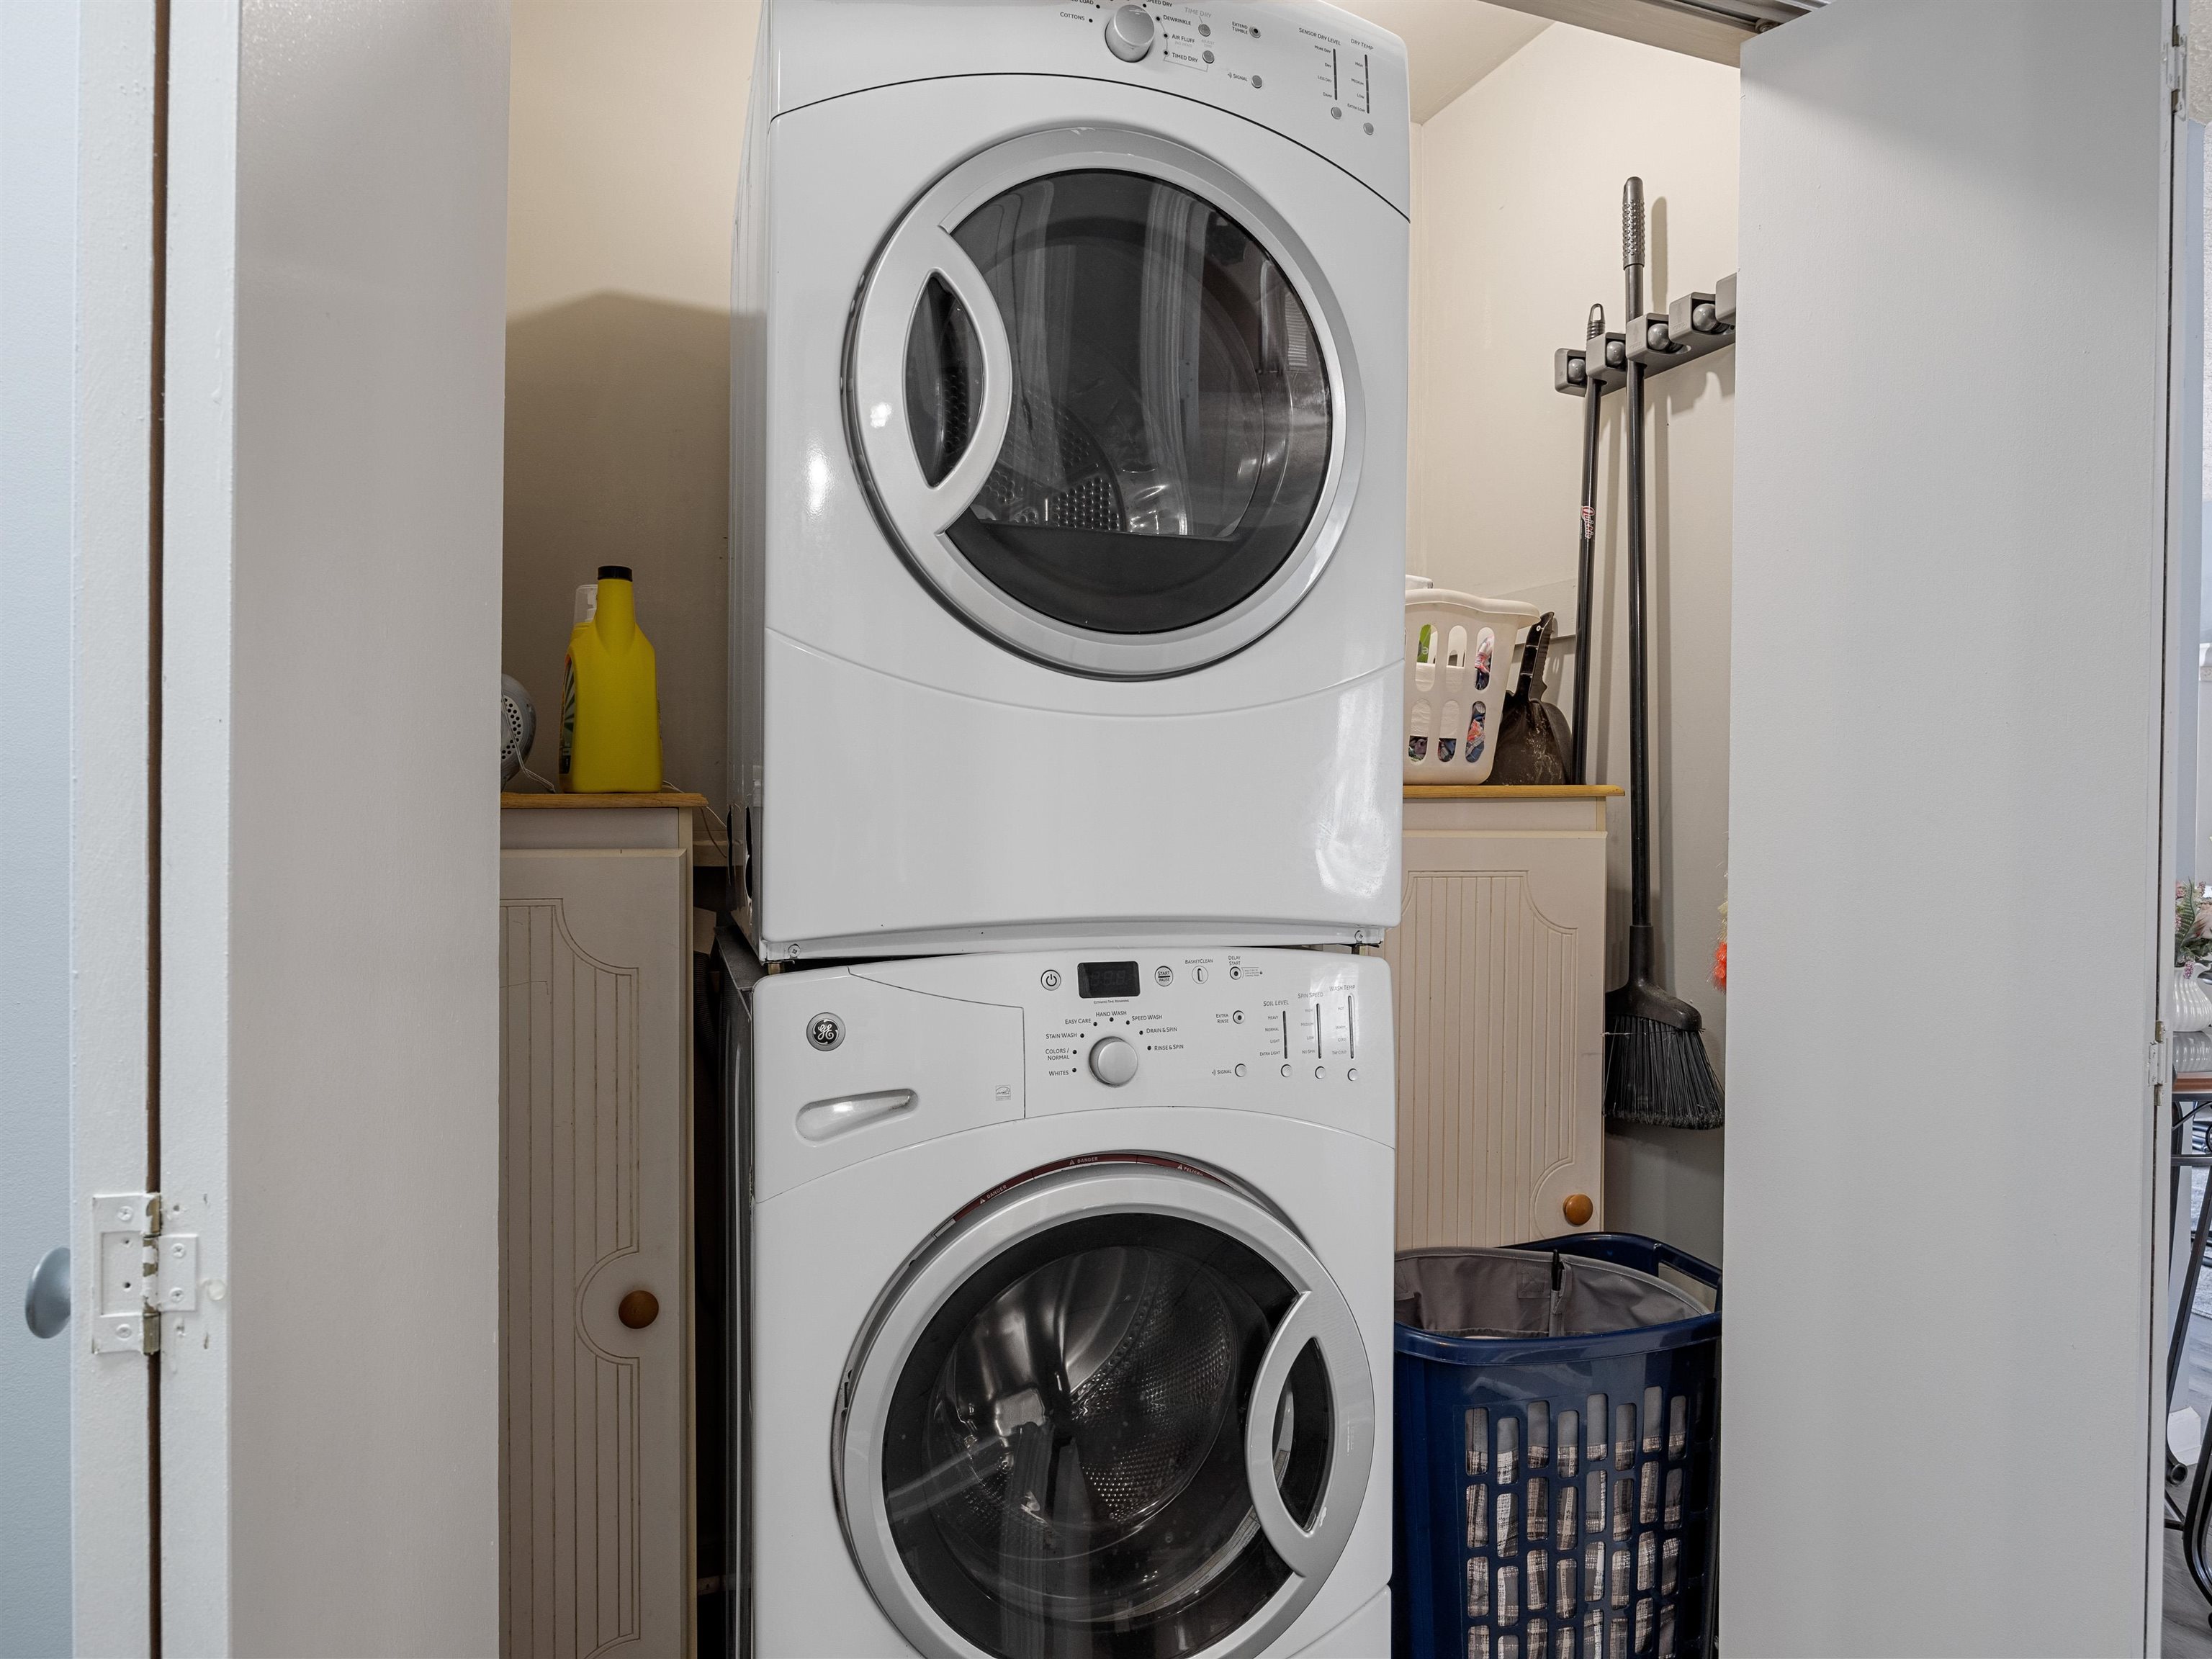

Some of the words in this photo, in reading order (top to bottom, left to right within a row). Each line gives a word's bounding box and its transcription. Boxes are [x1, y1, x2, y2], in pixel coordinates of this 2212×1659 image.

[1060, 12, 1085, 21] COTTONS
[1163, 14, 1191, 26] DEWRINKLE
[1299, 27, 1317, 37] SENSOR
[1328, 37, 1341, 46] LEVEL
[1172, 52, 1187, 60] TIMED
[1233, 73, 1248, 82] SIGNAL
[818, 1024, 835, 1040] GE
[986, 1185, 1007, 1199] DANGER
